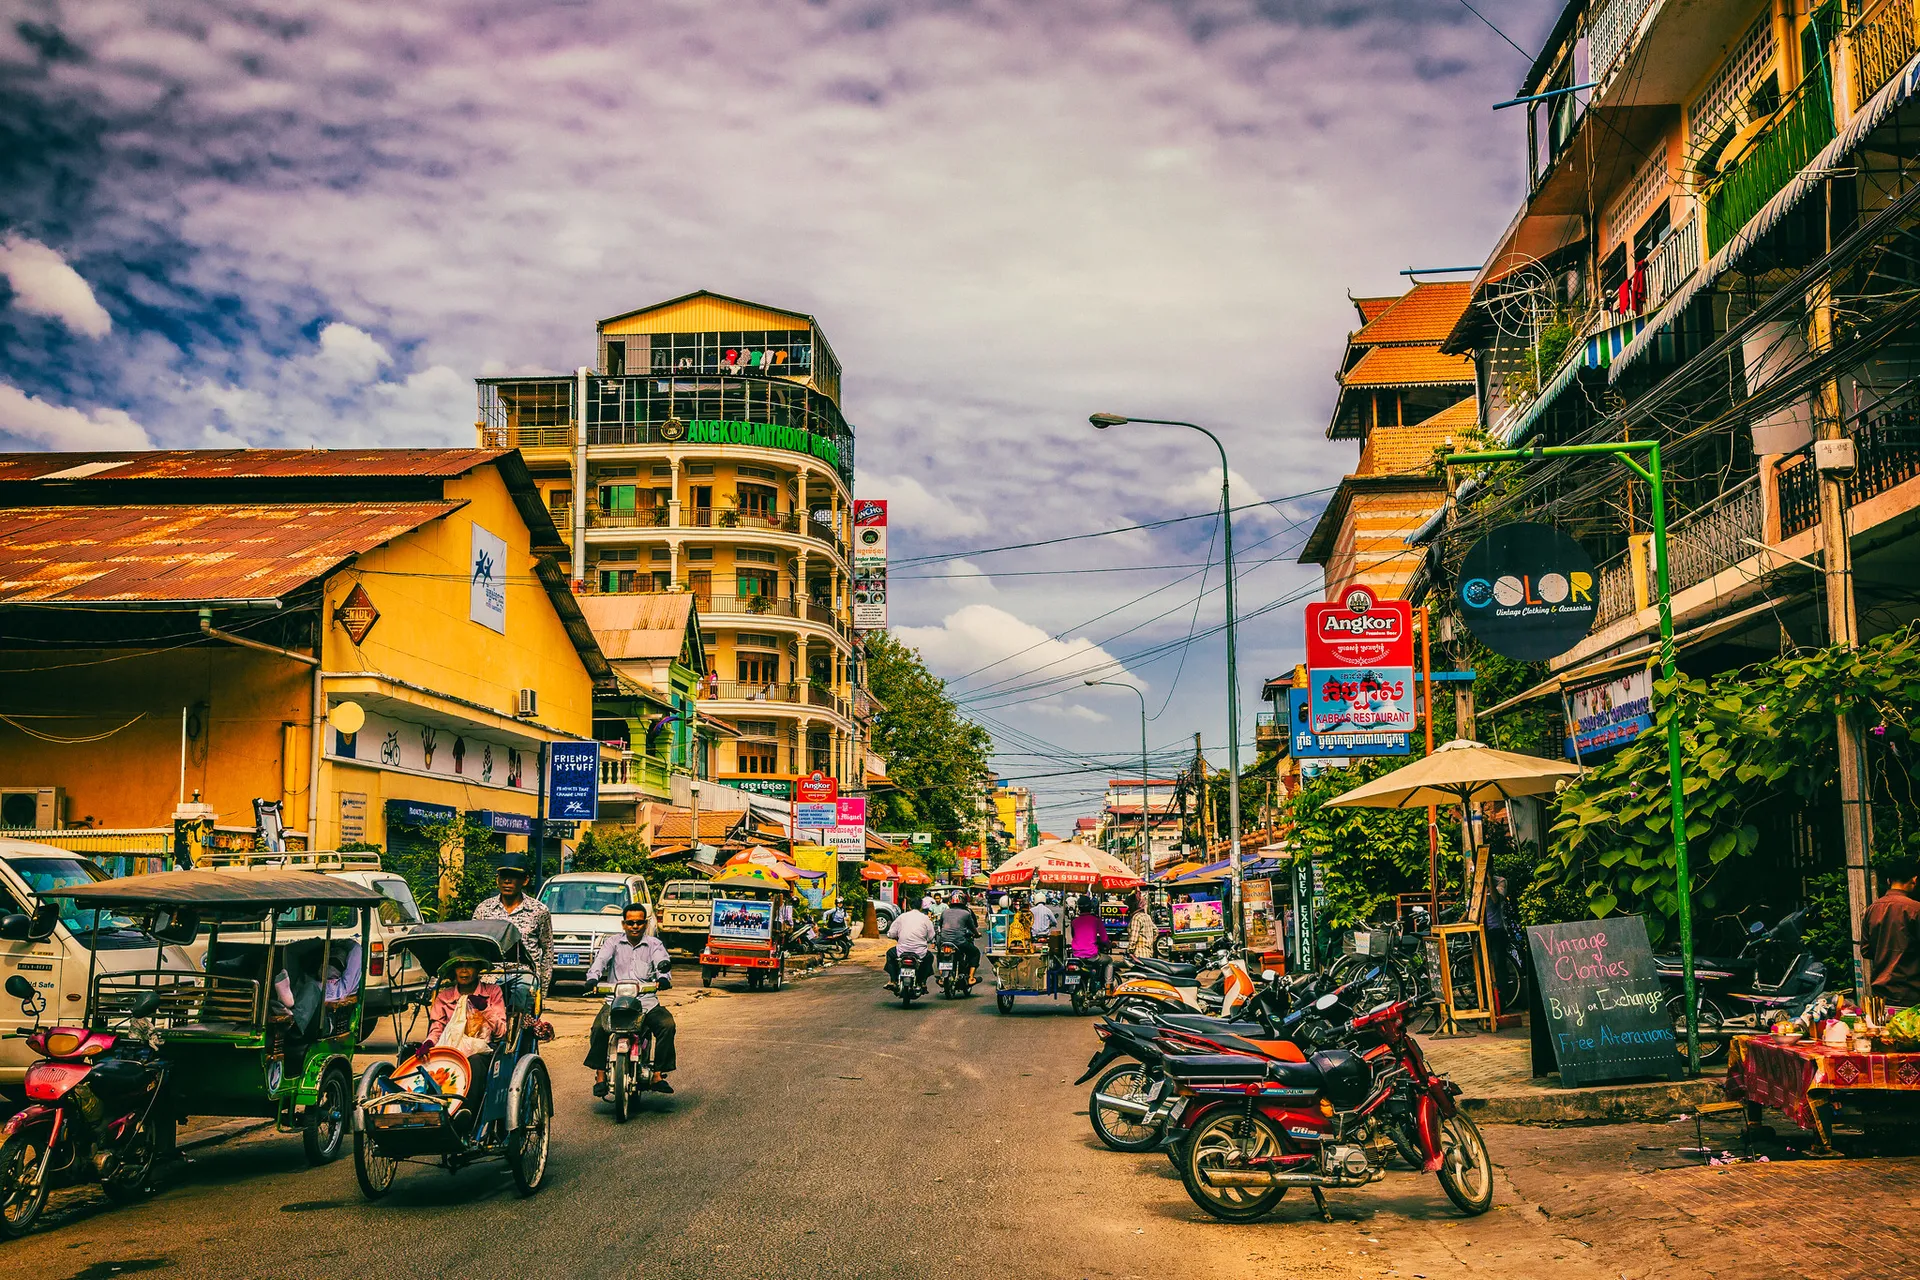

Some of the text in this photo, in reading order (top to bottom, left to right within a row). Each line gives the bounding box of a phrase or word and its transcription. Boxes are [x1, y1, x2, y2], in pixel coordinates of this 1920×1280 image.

[687, 420, 752, 444] ANGKOR
[753, 422, 808, 452] MITHONA
[1463, 572, 1592, 608] COLOR
[1522, 606, 1549, 616] Clothing
[1324, 616, 1395, 634] Angkor
[1316, 712, 1410, 723] KABBAS RESTAURANT
[554, 755, 594, 763] FRIENDS
[803, 782, 831, 790] Angkor
[841, 813, 862, 821] Miguel
[996, 871, 1030, 882] MOBILE
[1301, 905, 1311, 970] EXCHANGE
[1535, 930, 1608, 961] Vintage
[1555, 956, 1629, 981] Clothes
[1549, 998, 1585, 1026] Buy
[1596, 986, 1664, 1013] Exchange
[1558, 1033, 1595, 1053] Free
[1291, 1126, 1308, 1134] Citi
